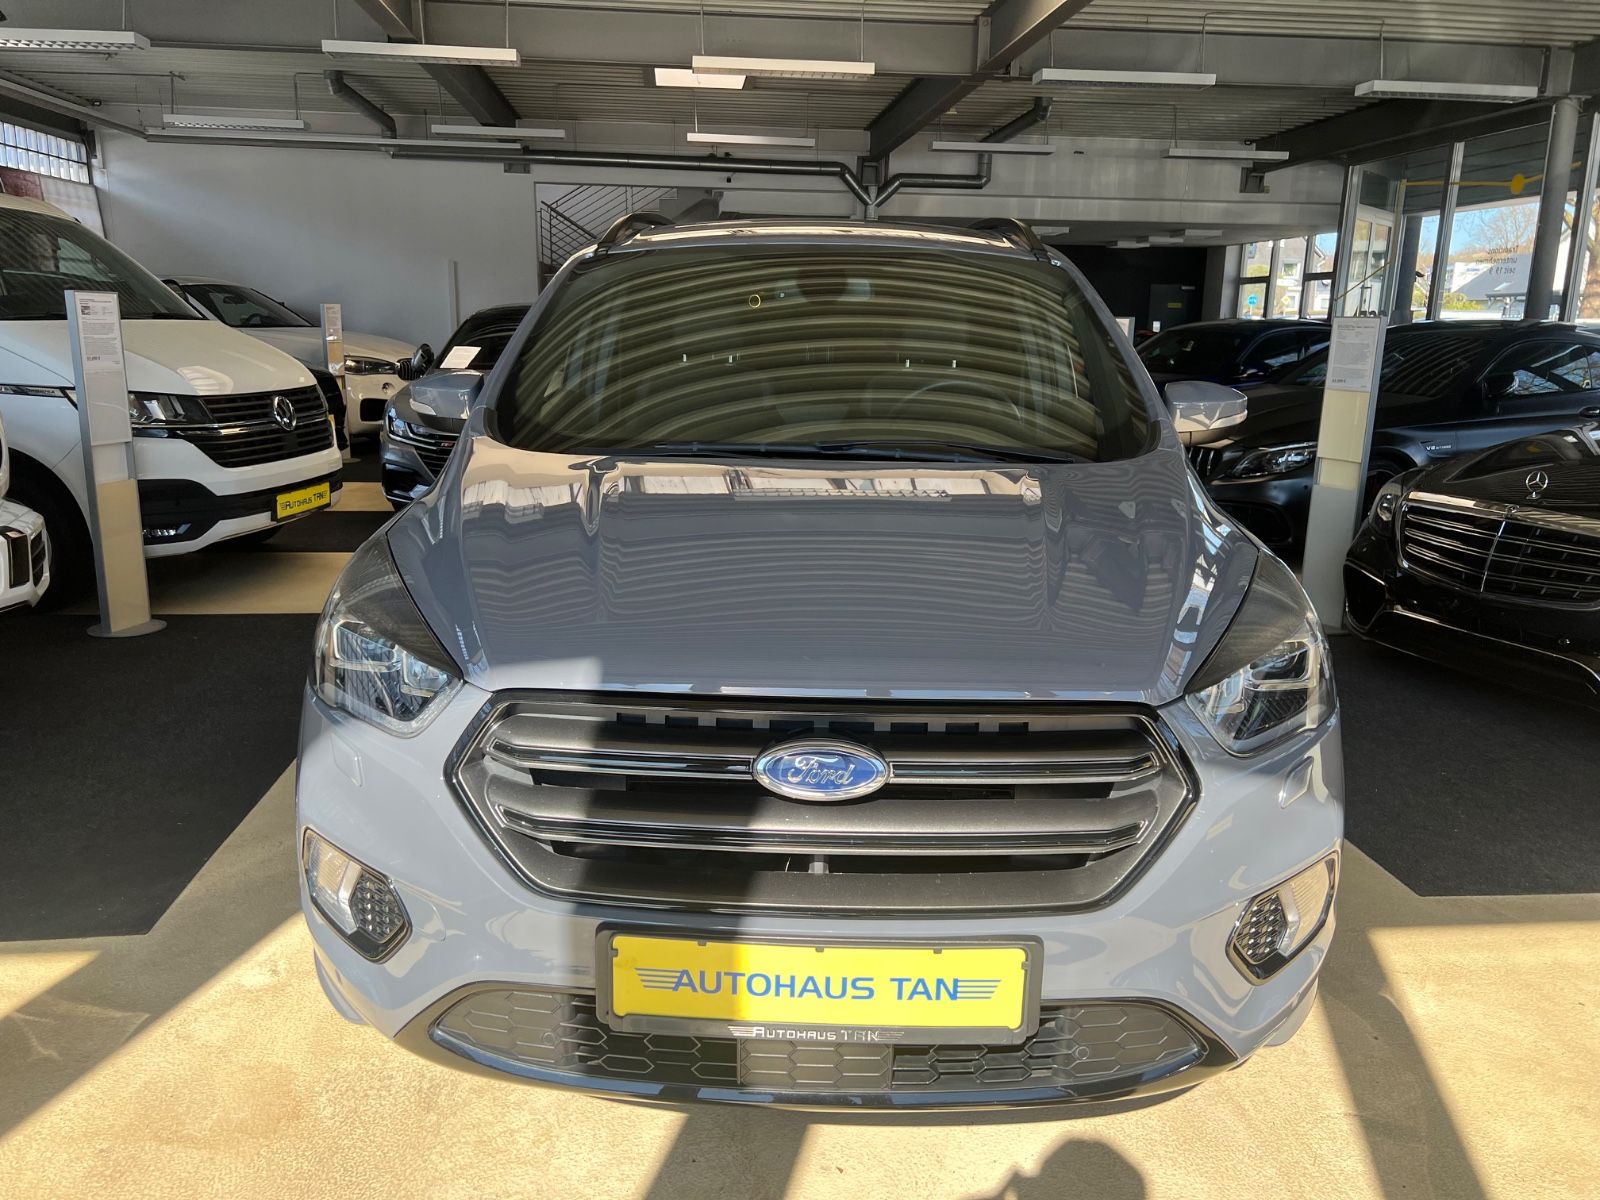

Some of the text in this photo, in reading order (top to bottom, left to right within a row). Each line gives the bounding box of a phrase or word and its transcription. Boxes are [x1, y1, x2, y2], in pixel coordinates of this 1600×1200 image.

[787, 755, 856, 785] Ford
[672, 968, 959, 1002] AUTOHAUS TAN
[840, 1029, 879, 1042] TAN
